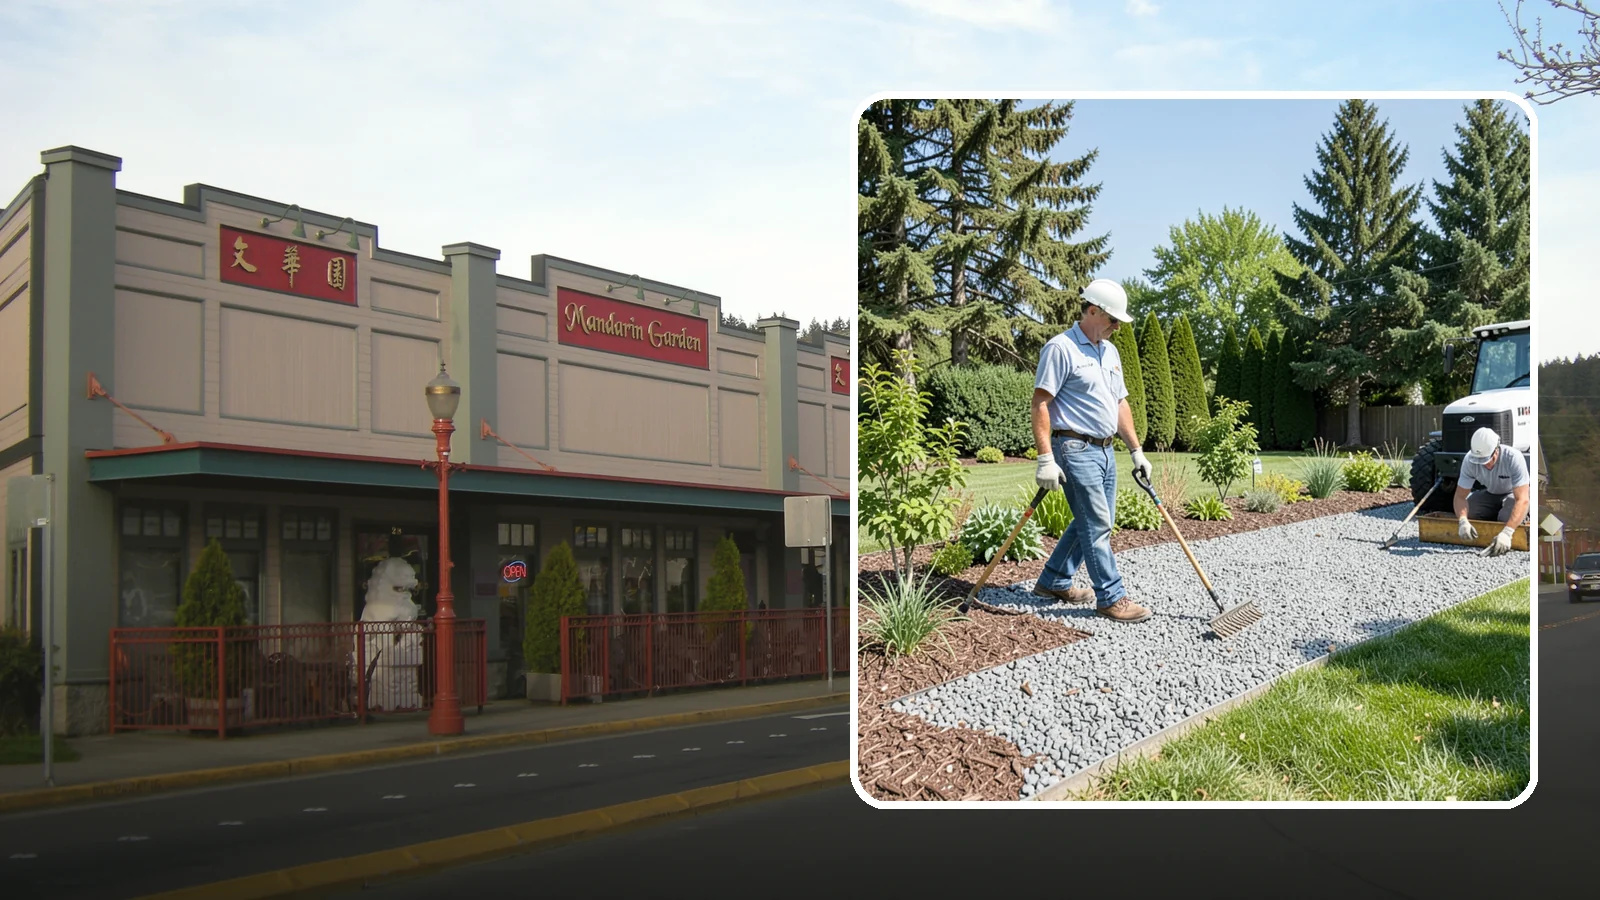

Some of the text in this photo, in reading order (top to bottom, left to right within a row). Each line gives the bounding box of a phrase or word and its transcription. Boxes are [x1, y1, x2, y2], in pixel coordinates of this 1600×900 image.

[231, 235, 346, 291] 文華園
[564, 302, 701, 352] Mandarin Garden
[503, 565, 527, 578] OPEN
